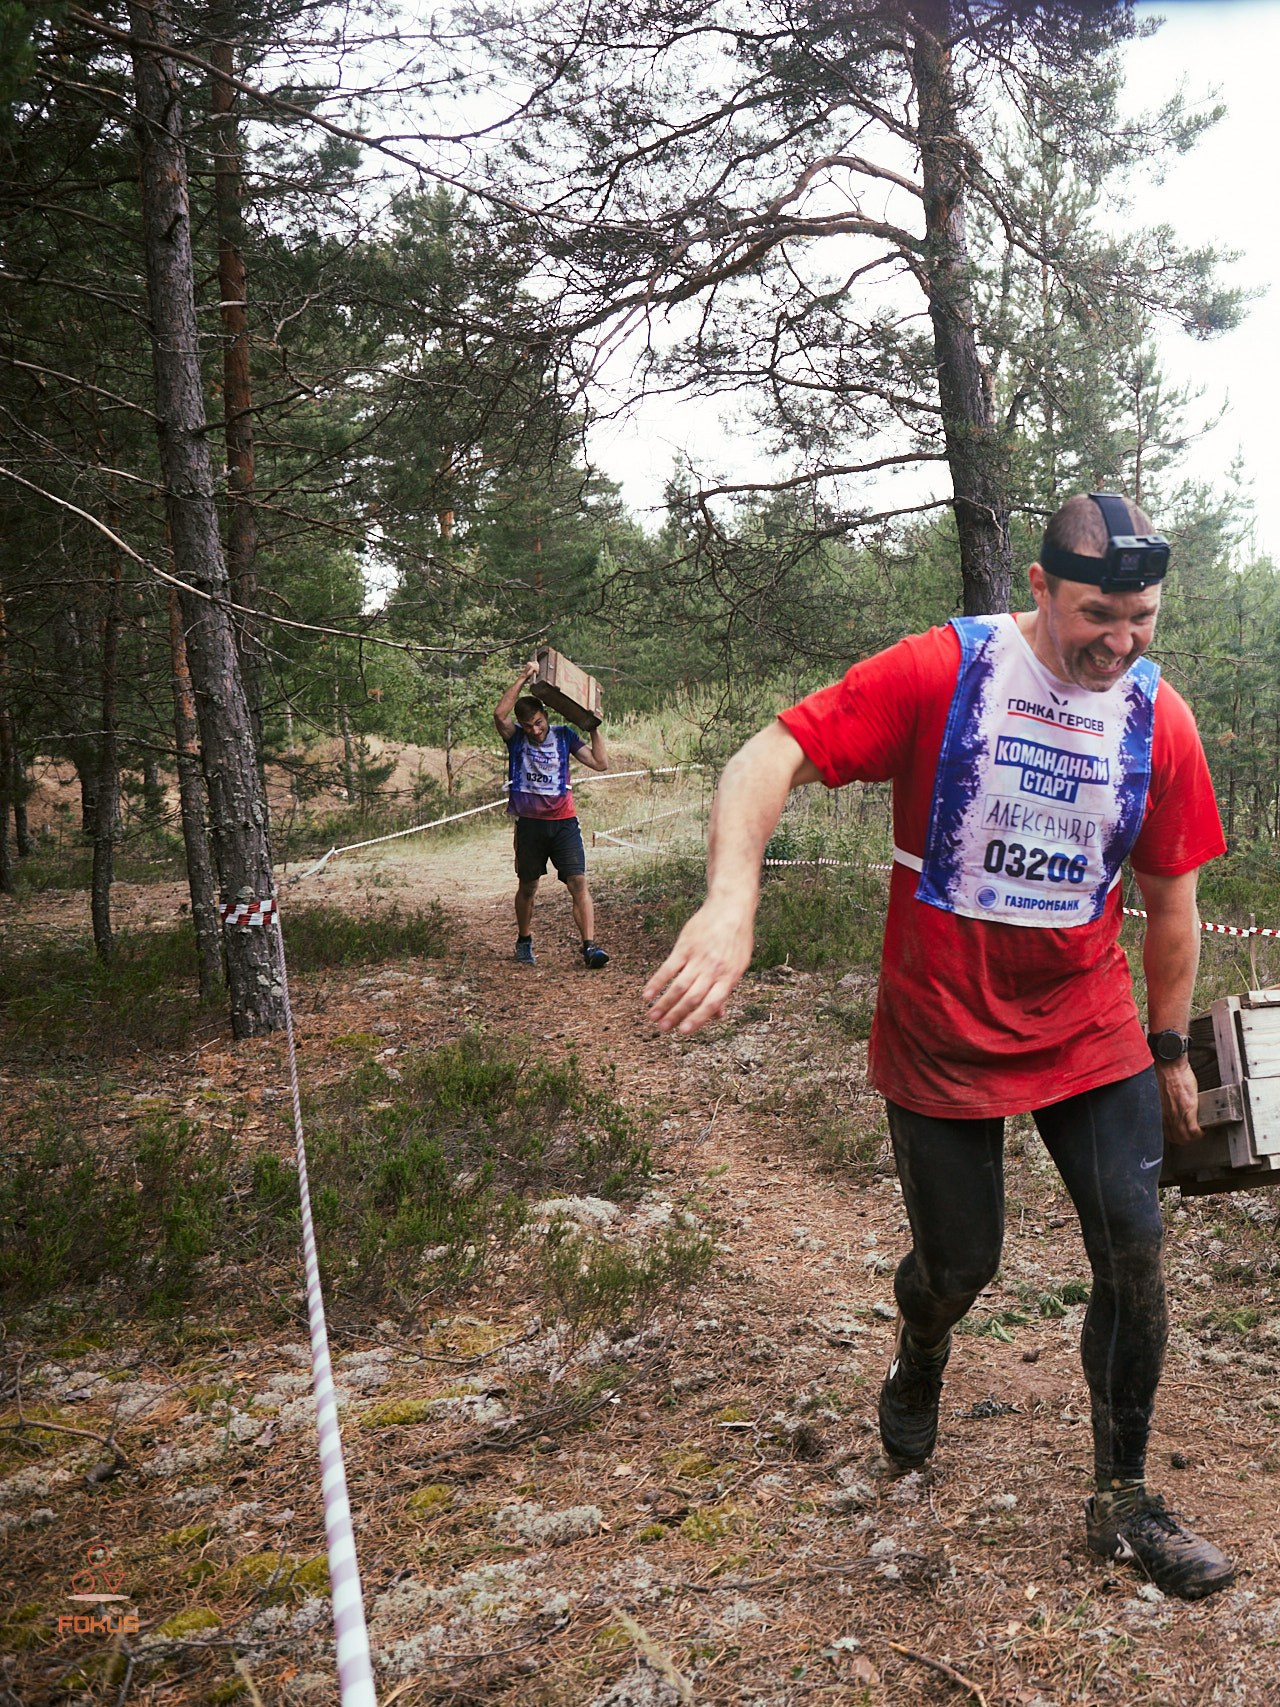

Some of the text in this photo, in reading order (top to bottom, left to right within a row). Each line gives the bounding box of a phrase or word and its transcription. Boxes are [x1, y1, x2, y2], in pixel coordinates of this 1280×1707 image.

[1008, 699, 1104, 732] ГОНКА ГЕРОЕВ
[997, 740, 1109, 782] КОМАНДНЫЙ
[526, 772, 553, 784] 03207
[1022, 769, 1076, 801] СТАРТ
[986, 799, 1096, 847] АЛЕКСАНДР
[983, 839, 1088, 884] 03206
[1005, 895, 1080, 911] ГАЗПРОМБАНК
